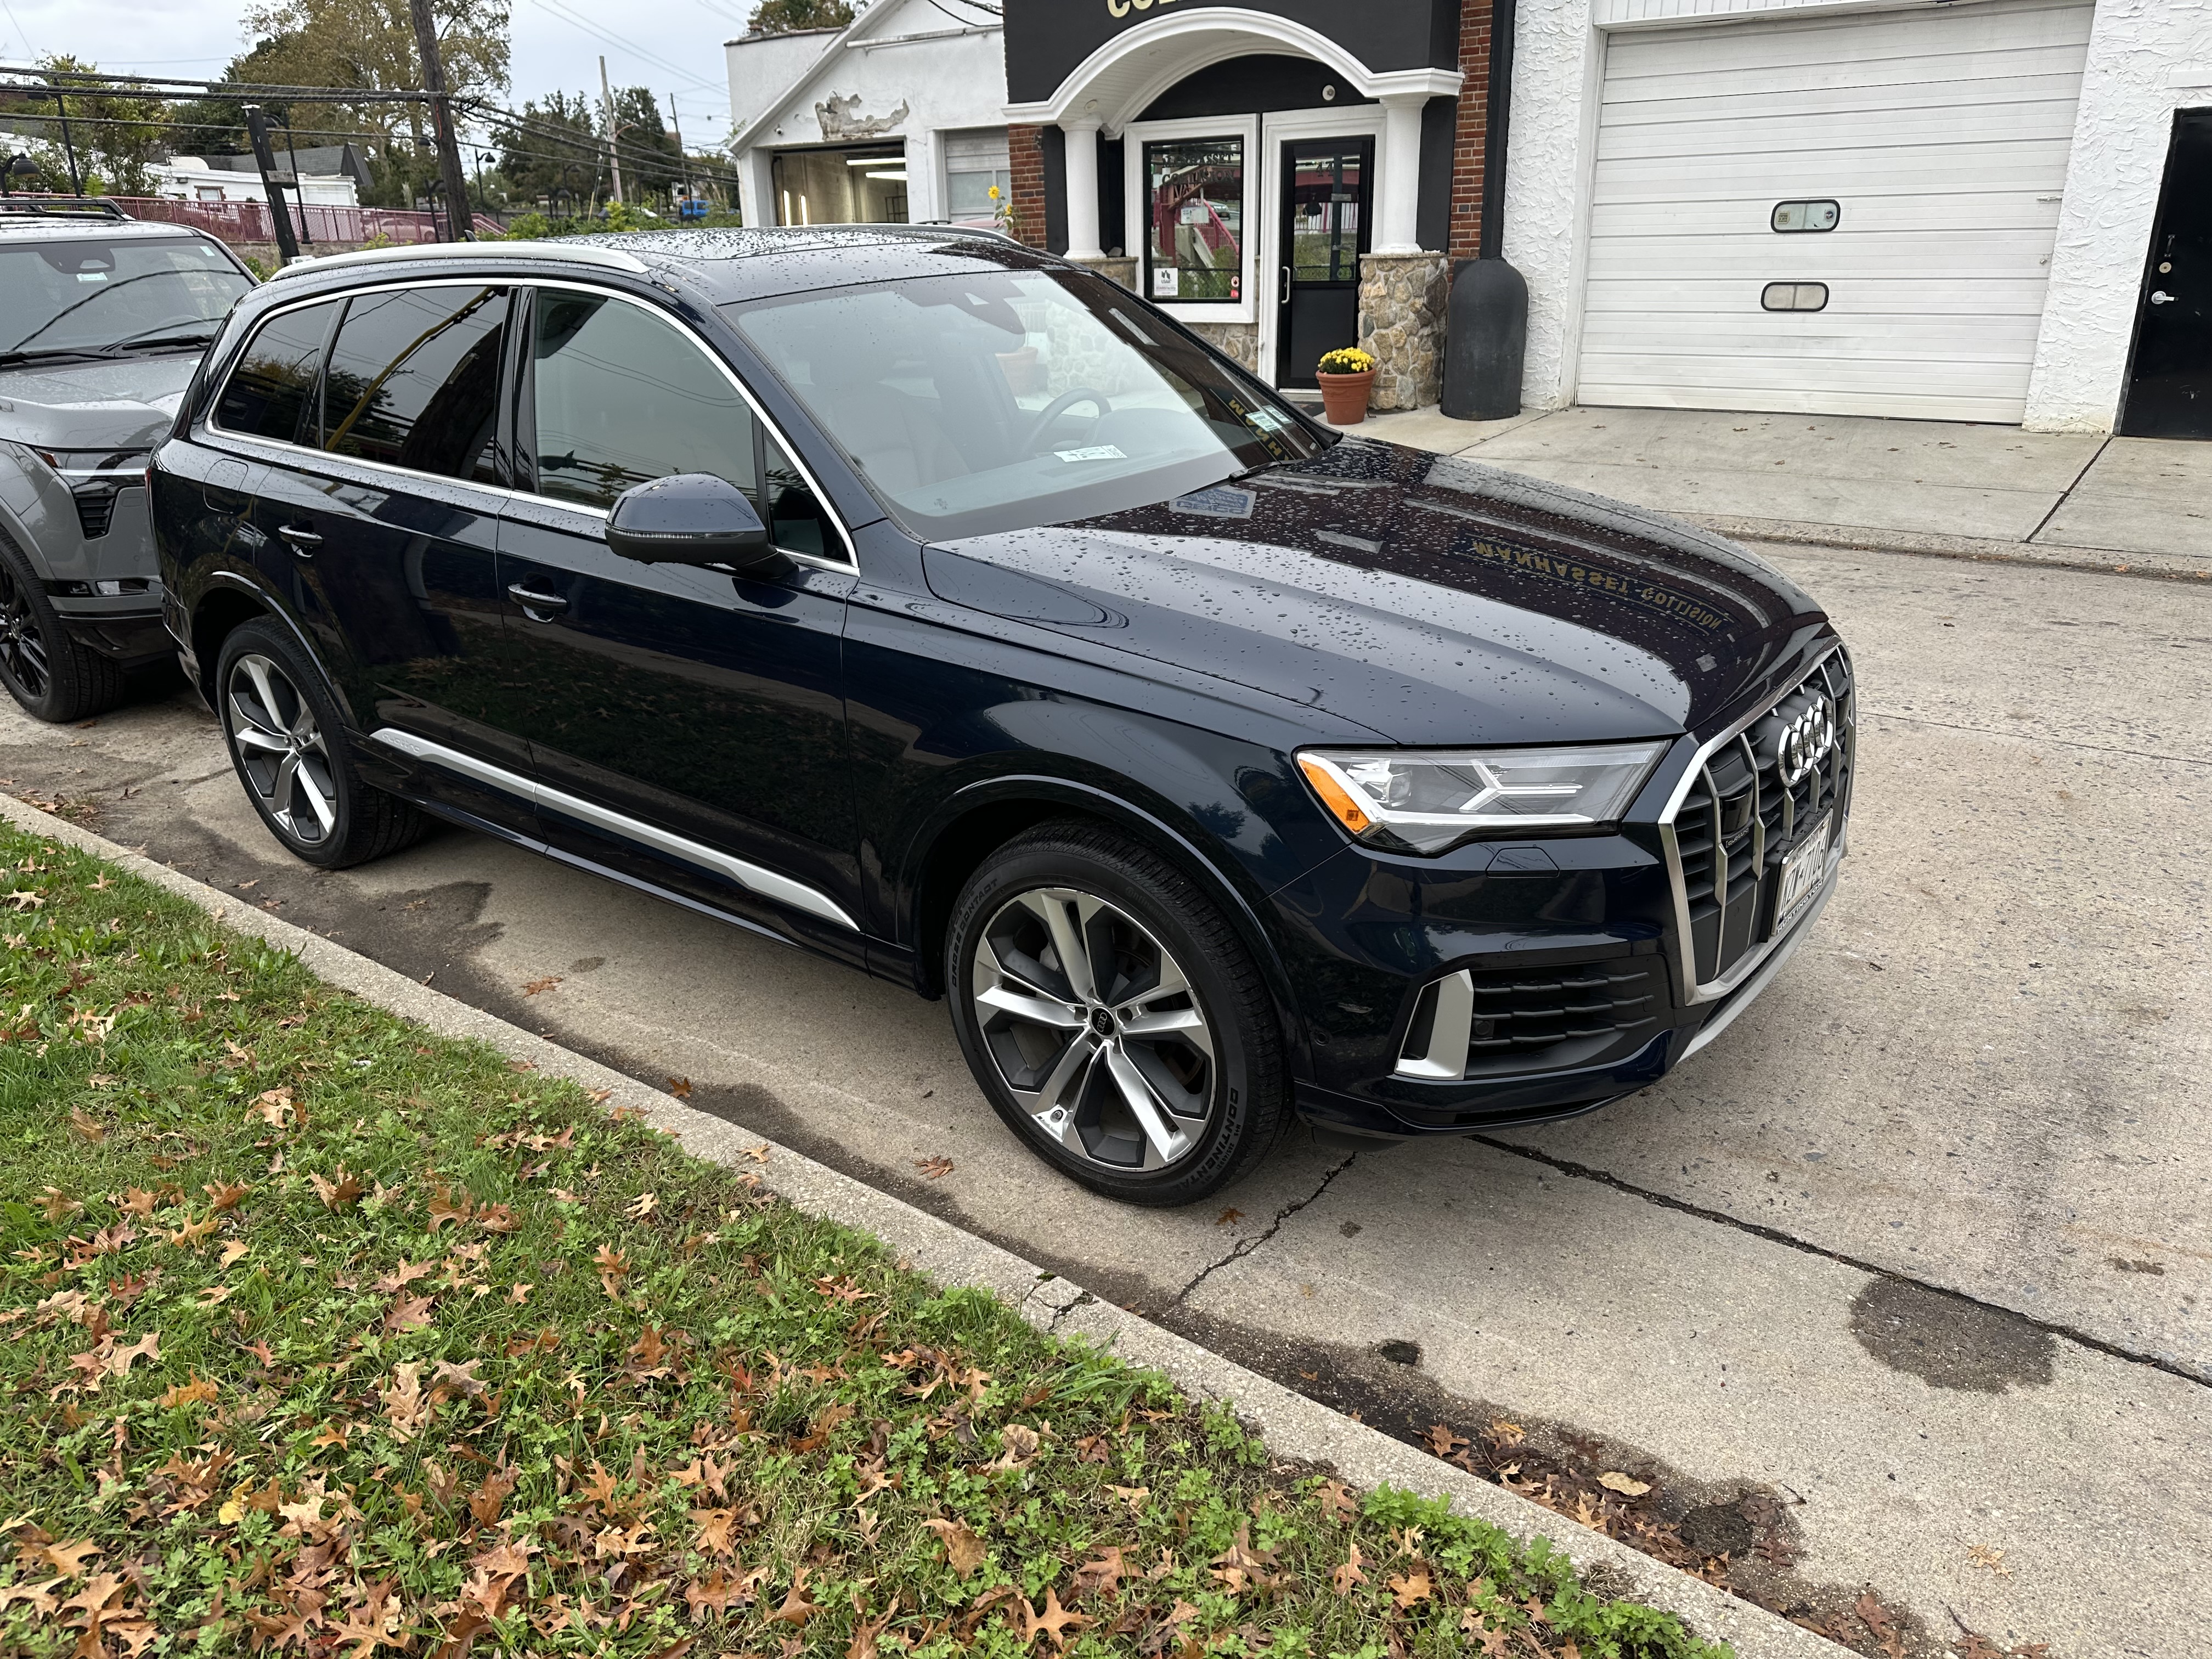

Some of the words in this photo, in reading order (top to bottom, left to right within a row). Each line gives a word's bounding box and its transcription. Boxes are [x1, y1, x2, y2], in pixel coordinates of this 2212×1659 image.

[1162, 170, 1234, 186] COLLISION
[382, 732, 420, 753] quattro
[1778, 883, 1822, 933] HUNTINGTON
[1172, 1087, 1238, 1192] CONTINENTAL
